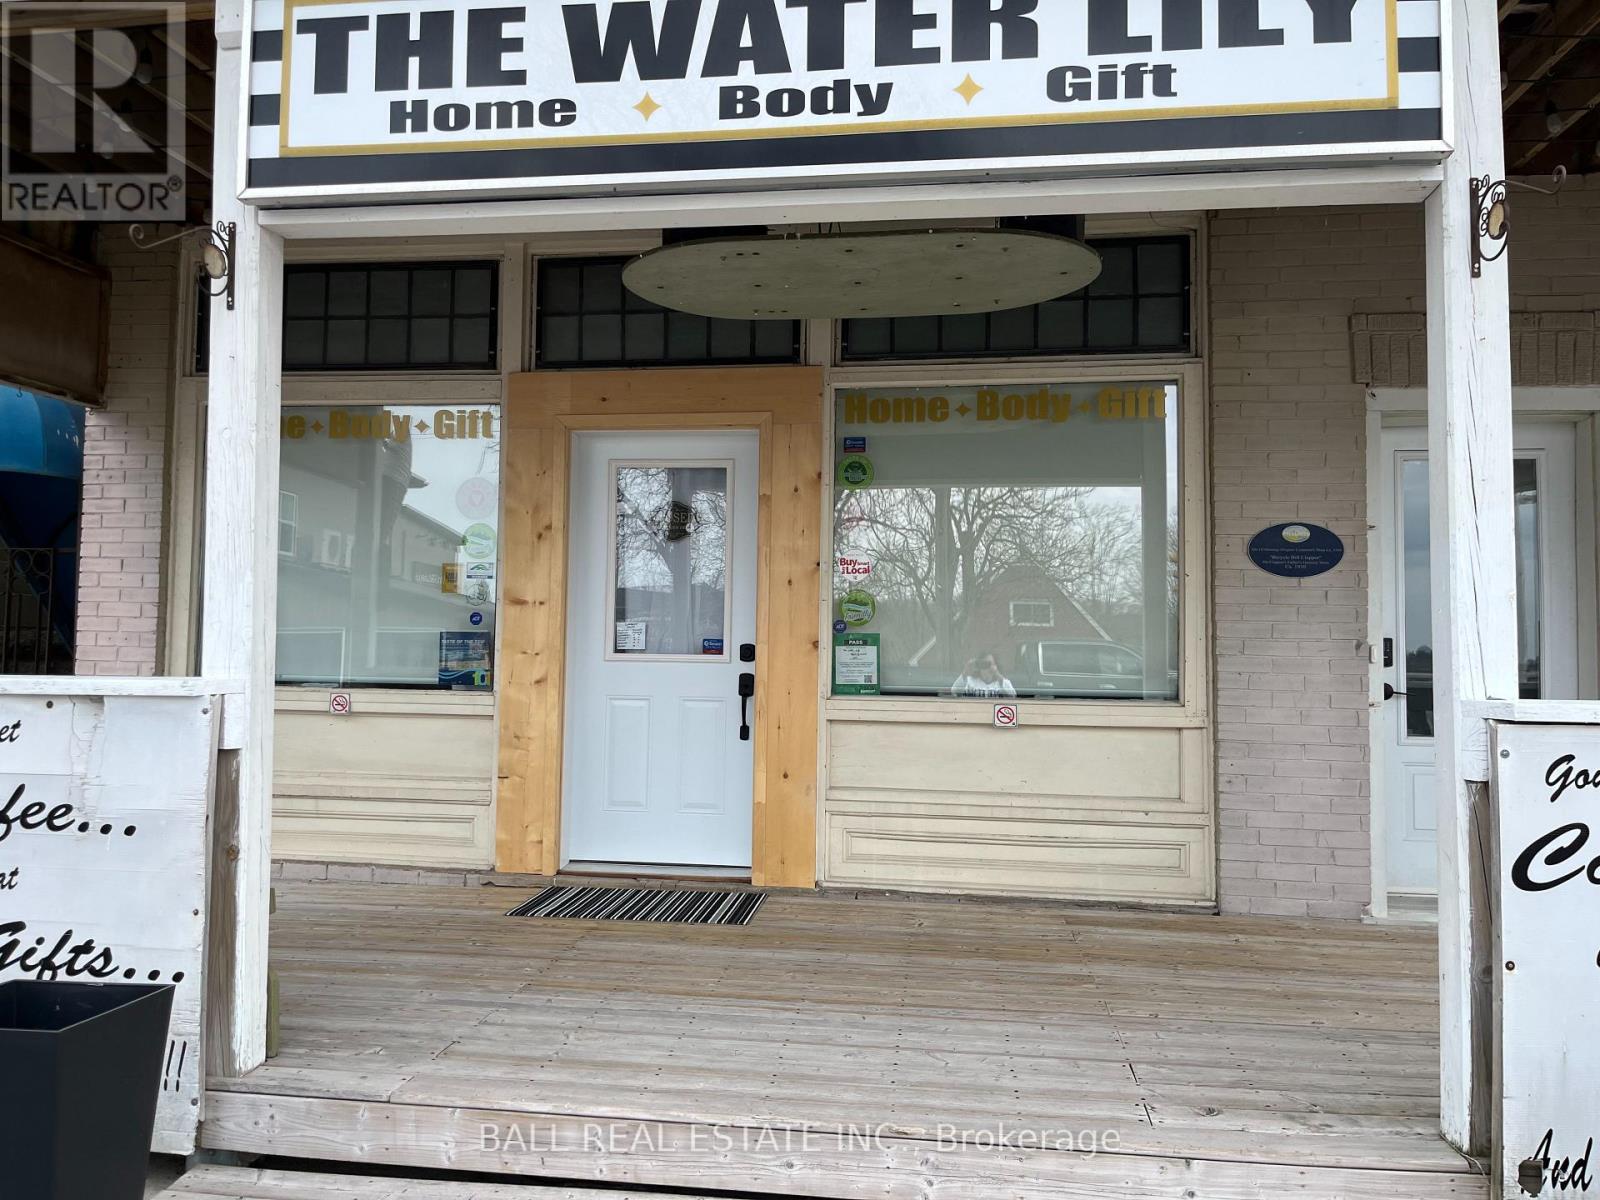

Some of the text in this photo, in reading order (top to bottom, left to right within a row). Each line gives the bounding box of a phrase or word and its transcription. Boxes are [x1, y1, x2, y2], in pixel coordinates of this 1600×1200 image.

[296, 0, 1360, 95] THE WATER LILY
[390, 62, 1177, 134] Home Body Gift
[844, 385, 1166, 424] Home Body Gift
[329, 409, 410, 443] Body
[433, 409, 494, 440] Gift
[840, 557, 857, 567] Buy
[846, 566, 871, 575] Local
